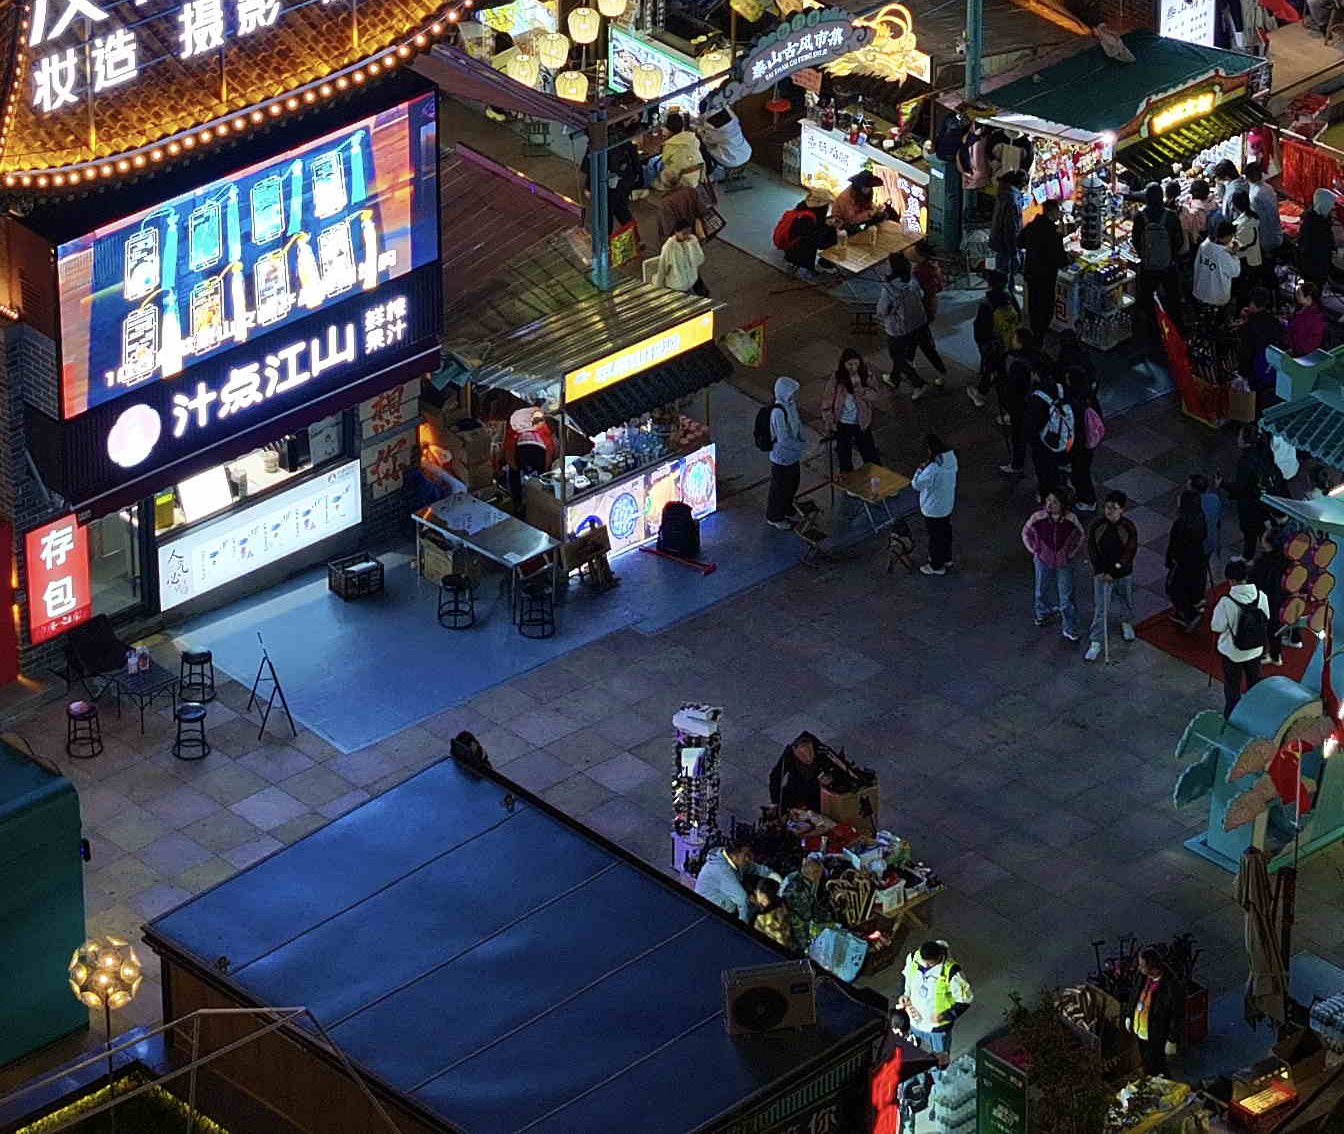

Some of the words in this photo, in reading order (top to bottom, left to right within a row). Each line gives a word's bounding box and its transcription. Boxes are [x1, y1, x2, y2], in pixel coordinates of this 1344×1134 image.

[32, 27, 138, 113] 妆造
[752, 26, 844, 81] 泰山古风市集
[172, 323, 356, 437] 汁点江山
[365, 320, 408, 355] 果汁
[40, 526, 76, 621] 存包
